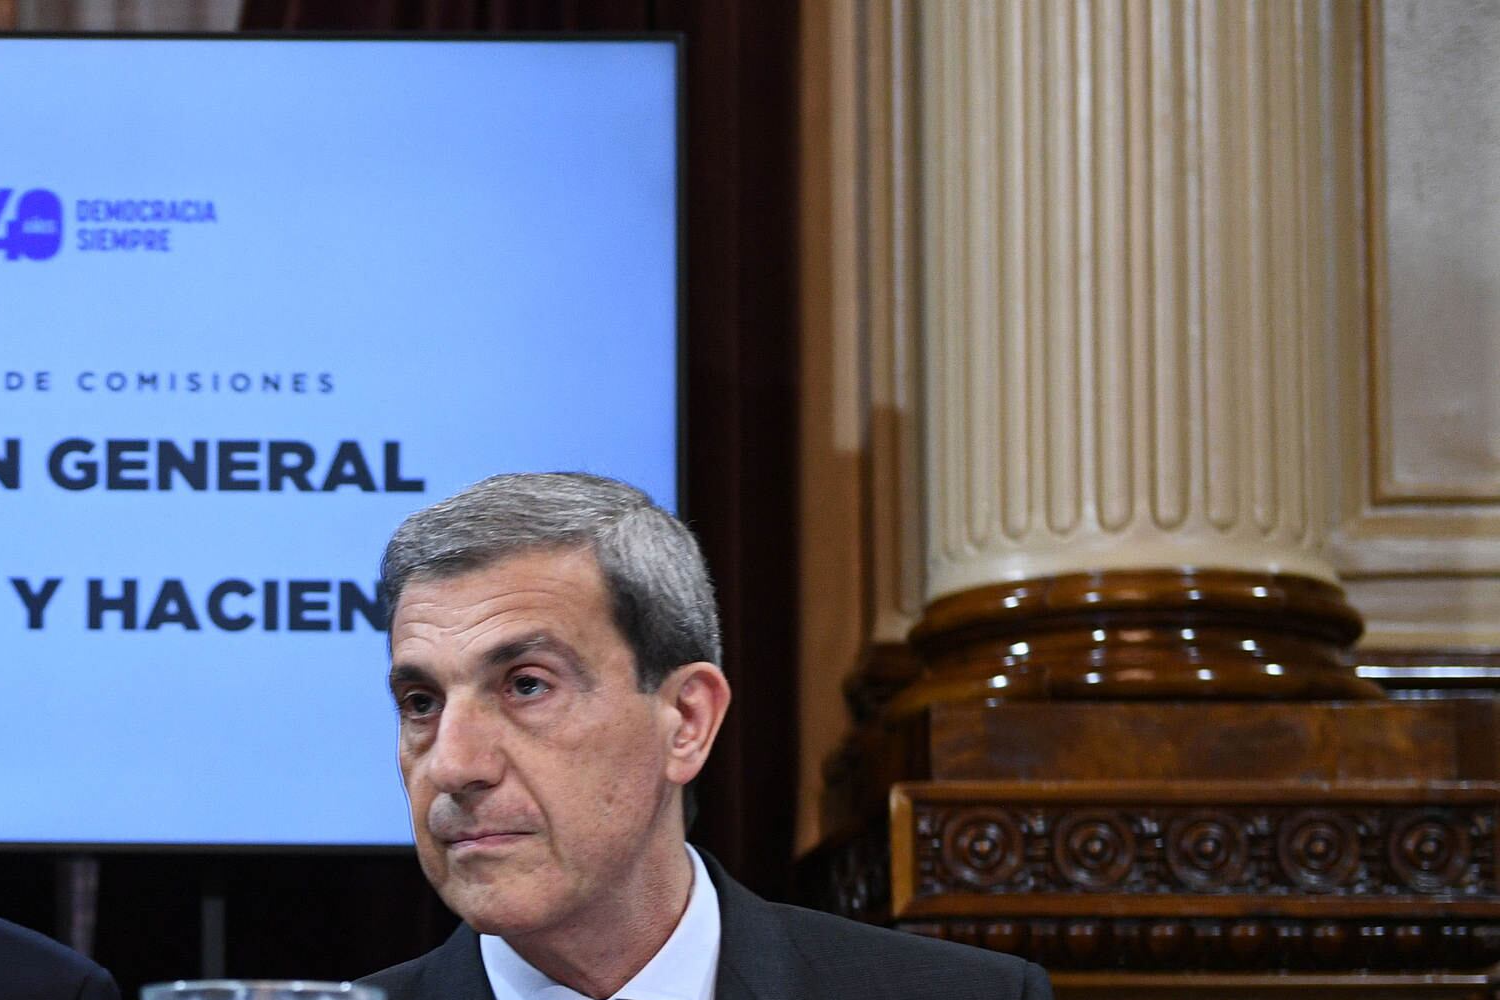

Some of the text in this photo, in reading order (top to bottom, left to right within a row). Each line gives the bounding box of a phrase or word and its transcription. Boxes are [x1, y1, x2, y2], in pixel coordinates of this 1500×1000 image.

[76, 199, 217, 223] DEMOCRACIA
[76, 227, 171, 253] SIEMPRE
[4, 370, 50, 392] DE
[76, 371, 334, 395] COMISIONES
[45, 437, 427, 493] GENERAL
[10, 577, 63, 631] Y
[86, 577, 390, 633] HACIEN
